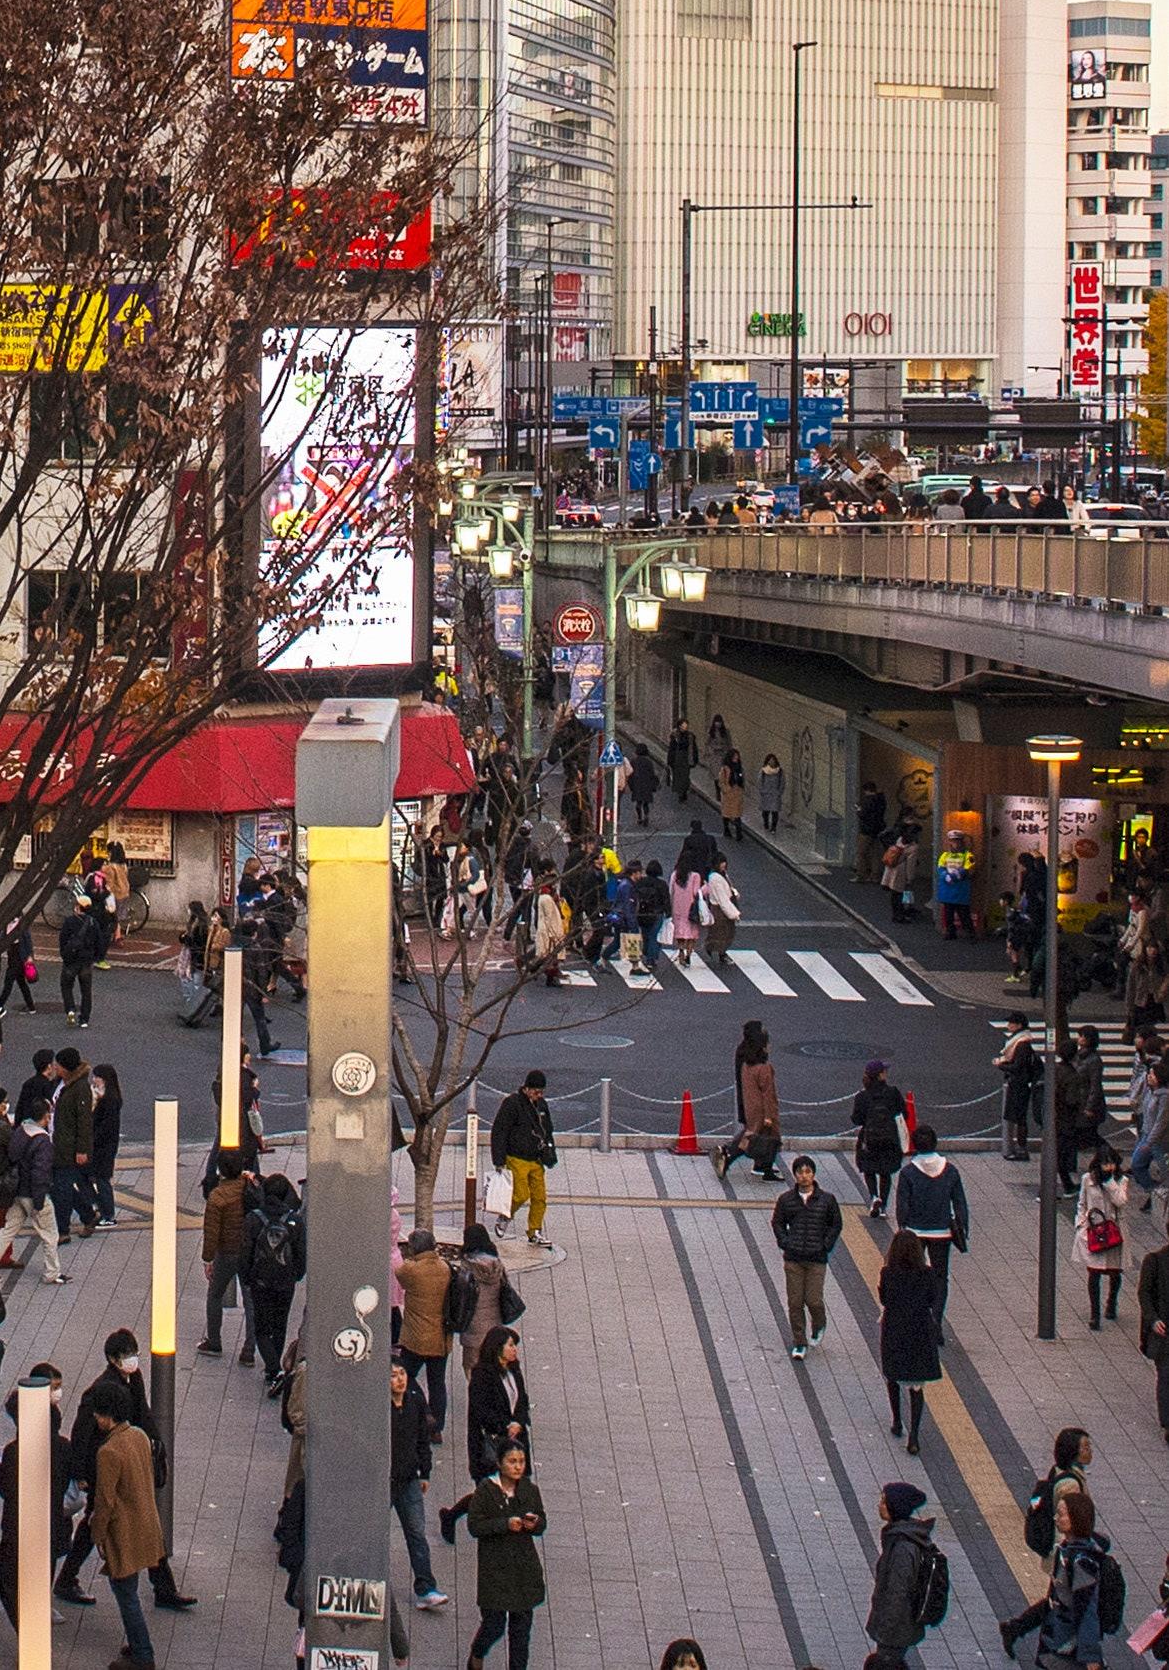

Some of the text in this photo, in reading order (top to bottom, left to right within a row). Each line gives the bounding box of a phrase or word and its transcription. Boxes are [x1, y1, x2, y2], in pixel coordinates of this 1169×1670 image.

[1072, 266, 1101, 387] 世界堂
[562, 618, 592, 634] 消火栓
